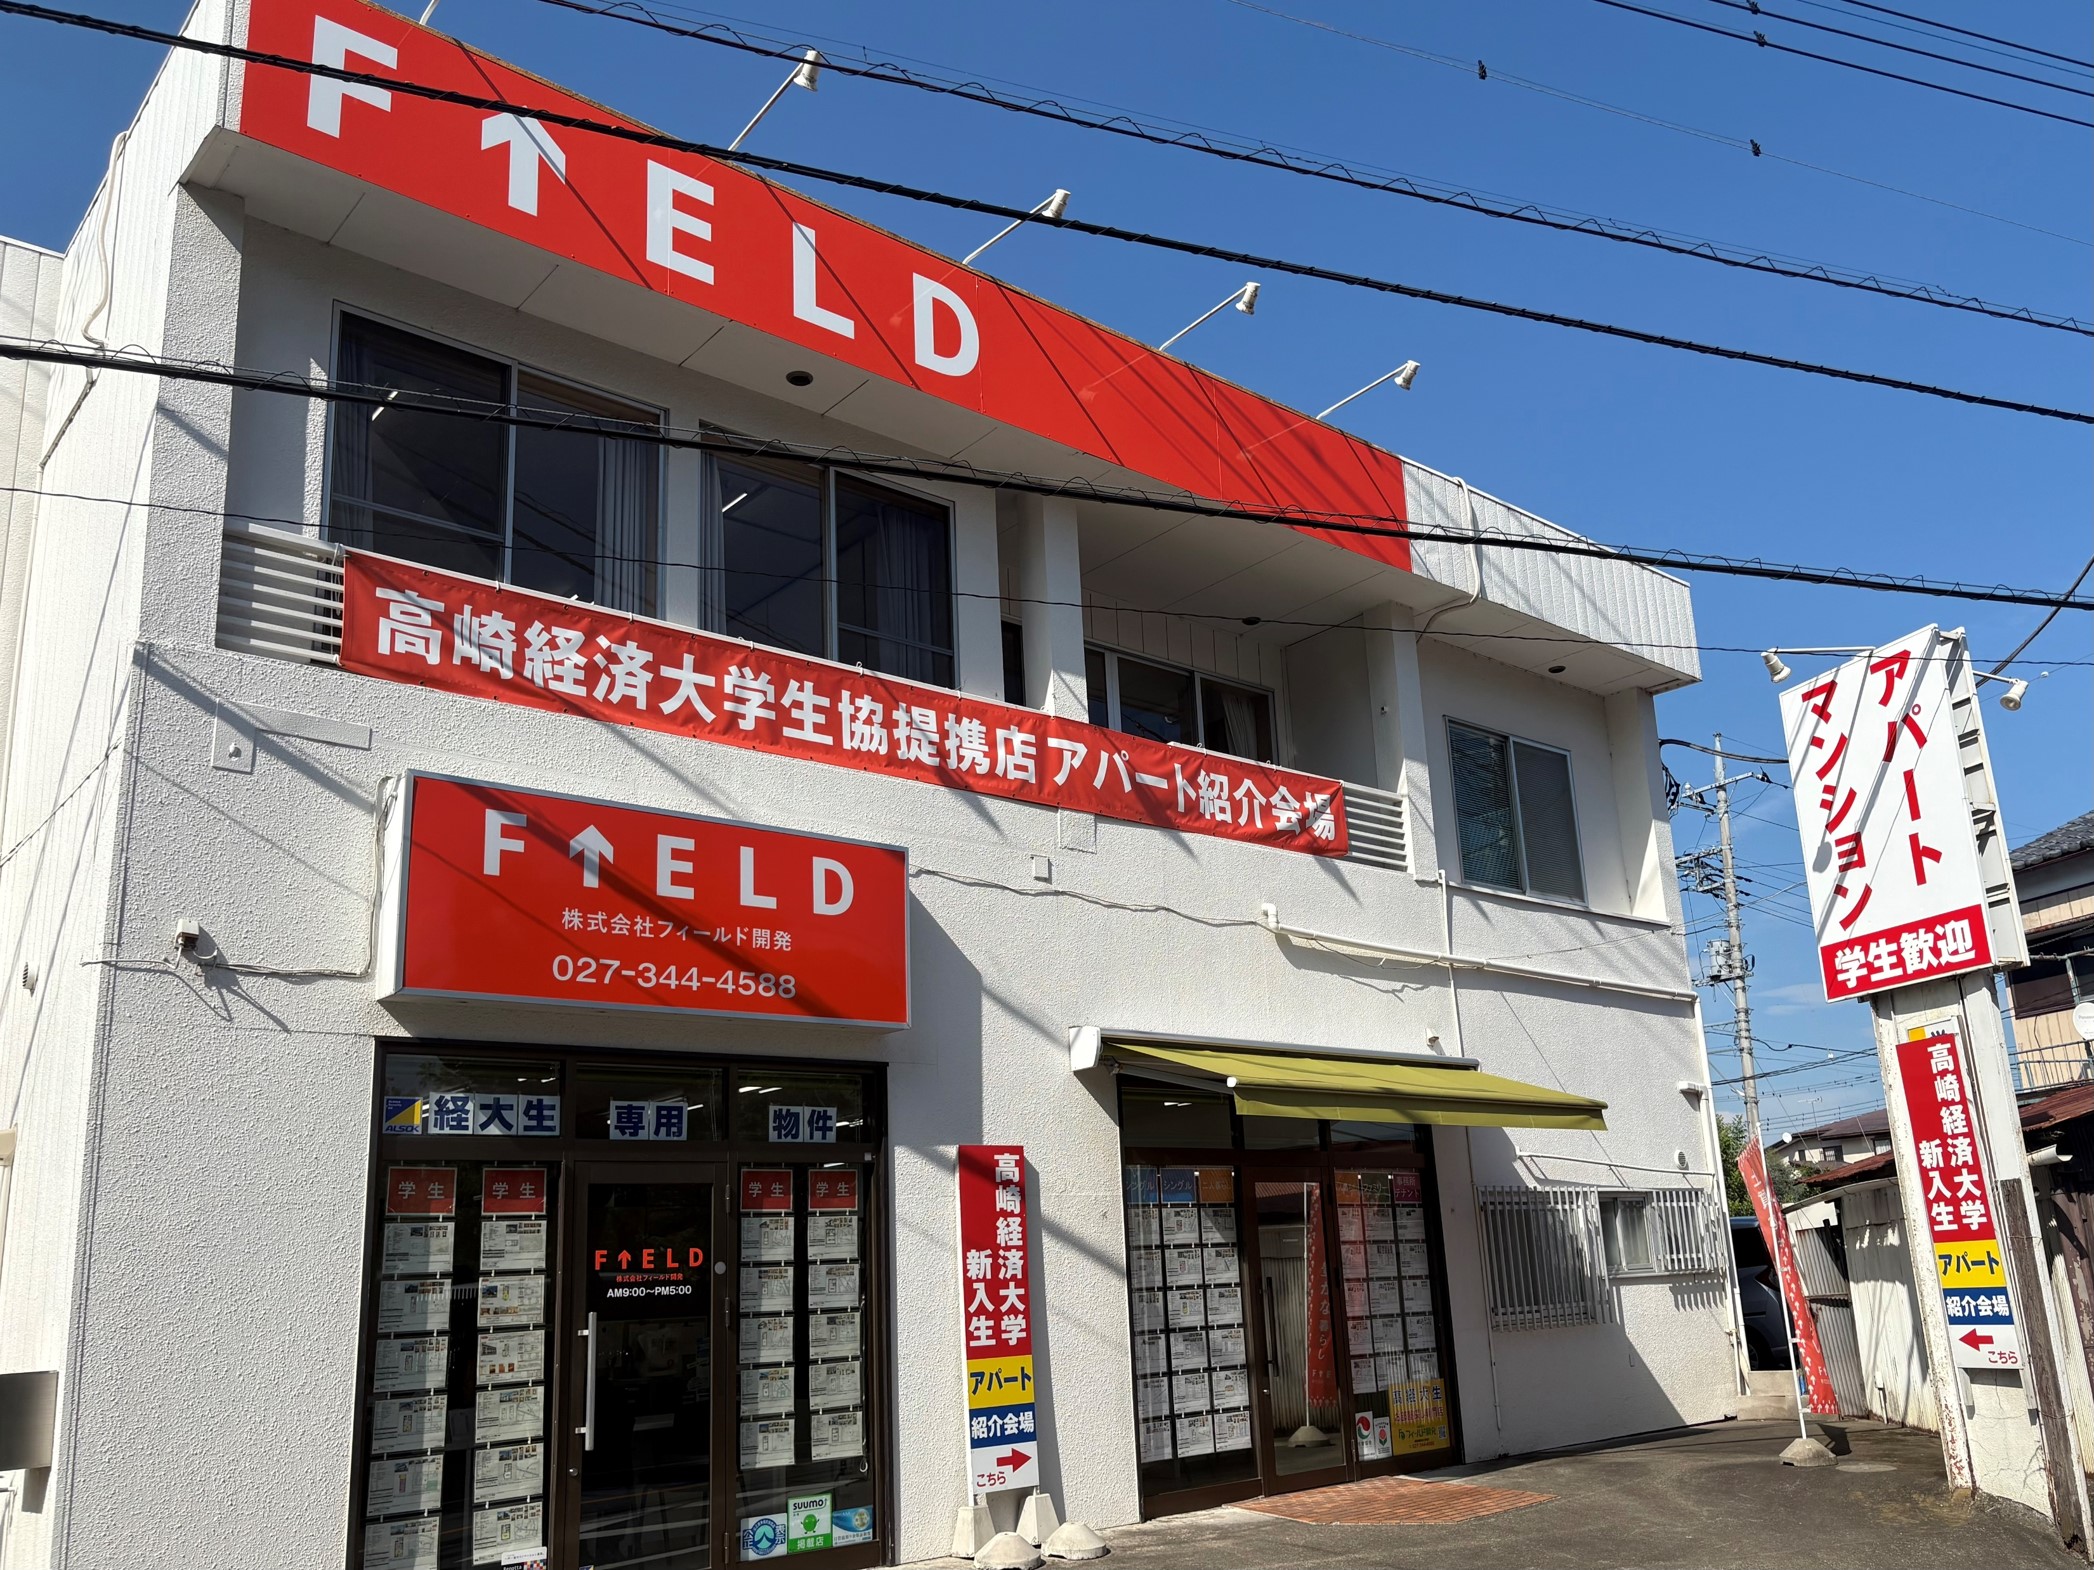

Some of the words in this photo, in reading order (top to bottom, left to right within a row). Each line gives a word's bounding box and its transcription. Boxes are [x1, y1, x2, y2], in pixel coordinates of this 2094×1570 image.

[375, 588, 1337, 842] 高崎経済大学生協提携店アパート紹介会場
[1870, 649, 1942, 886] アパート
[1802, 680, 1872, 930] マンション
[561, 907, 792, 952] 株式会社フィールド開発
[1835, 919, 1975, 989] 学生歓迎
[552, 955, 797, 999] 027-344-4588
[385, 1125, 420, 1133] ALSOK
[433, 1095, 556, 1133] 経大生
[614, 1104, 685, 1138] 専用
[772, 1108, 834, 1140] 物件
[1927, 1042, 1988, 1231] 高崎経済大学
[398, 1181, 445, 1200] 学生
[492, 1181, 536, 1200] 学生
[748, 1181, 785, 1198] 学生
[816, 1181, 850, 1198] 学生
[1164, 1180, 1193, 1191] シングル
[1919, 1138, 1958, 1231] 新入生
[993, 1153, 1027, 1346] 高崎経済大学
[1940, 1249, 2000, 1277] アパート
[966, 1248, 997, 1347] 新入生
[1946, 1296, 2010, 1318] 紹介会場
[1987, 1350, 2018, 1364] こちら
[970, 1366, 1032, 1395] アパート
[971, 1412, 1035, 1439] 紹介会場
[976, 1471, 1006, 1488] こちら
